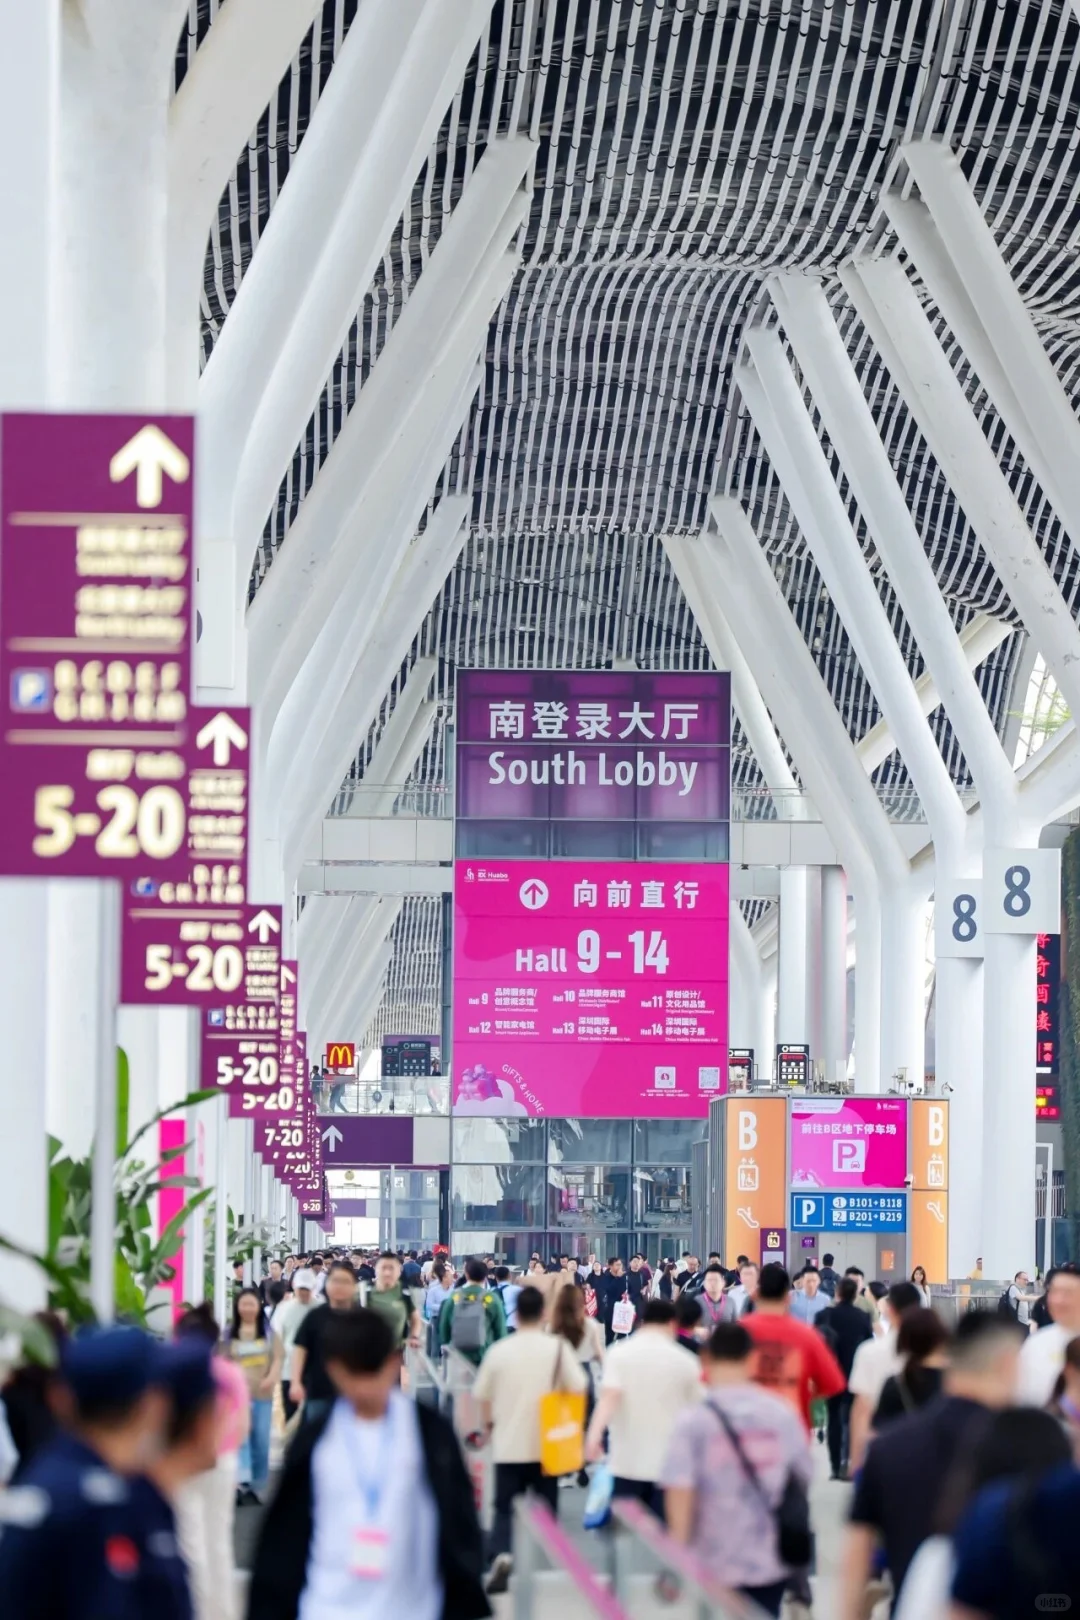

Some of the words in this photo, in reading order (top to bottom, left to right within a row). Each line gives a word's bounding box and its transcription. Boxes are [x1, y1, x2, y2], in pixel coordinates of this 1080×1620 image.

[489, 700, 699, 740] 南登录大厅
[489, 750, 586, 785] South
[599, 751, 698, 796] Lobby
[33, 785, 185, 858] 5-20
[573, 879, 699, 909] 向前直行
[1003, 865, 1031, 917] 8
[951, 894, 977, 942] 8
[145, 943, 244, 991] 5-20
[515, 948, 567, 973] Hall
[481, 993, 489, 1005] 9
[564, 990, 575, 1002] 10
[652, 995, 663, 1008] 11
[665, 999, 706, 1009] 文化用品馆
[480, 1021, 491, 1034] 12
[563, 1022, 575, 1034] 13
[652, 1023, 663, 1036] 14
[217, 1056, 278, 1085] 5-20
[502, 1064, 524, 1084] GIFTS
[523, 1089, 545, 1114] HOME
[264, 1128, 304, 1147] 7-20
[738, 1111, 758, 1151] B
[802, 1123, 897, 1135] 前往B区地下停车场
[928, 1107, 944, 1146] B
[303, 1203, 321, 1211] 9-20
[802, 1199, 816, 1223] P
[849, 1198, 872, 1207] B101
[880, 1199, 902, 1208] B118
[849, 1212, 872, 1221] B201
[880, 1212, 902, 1222] B219
